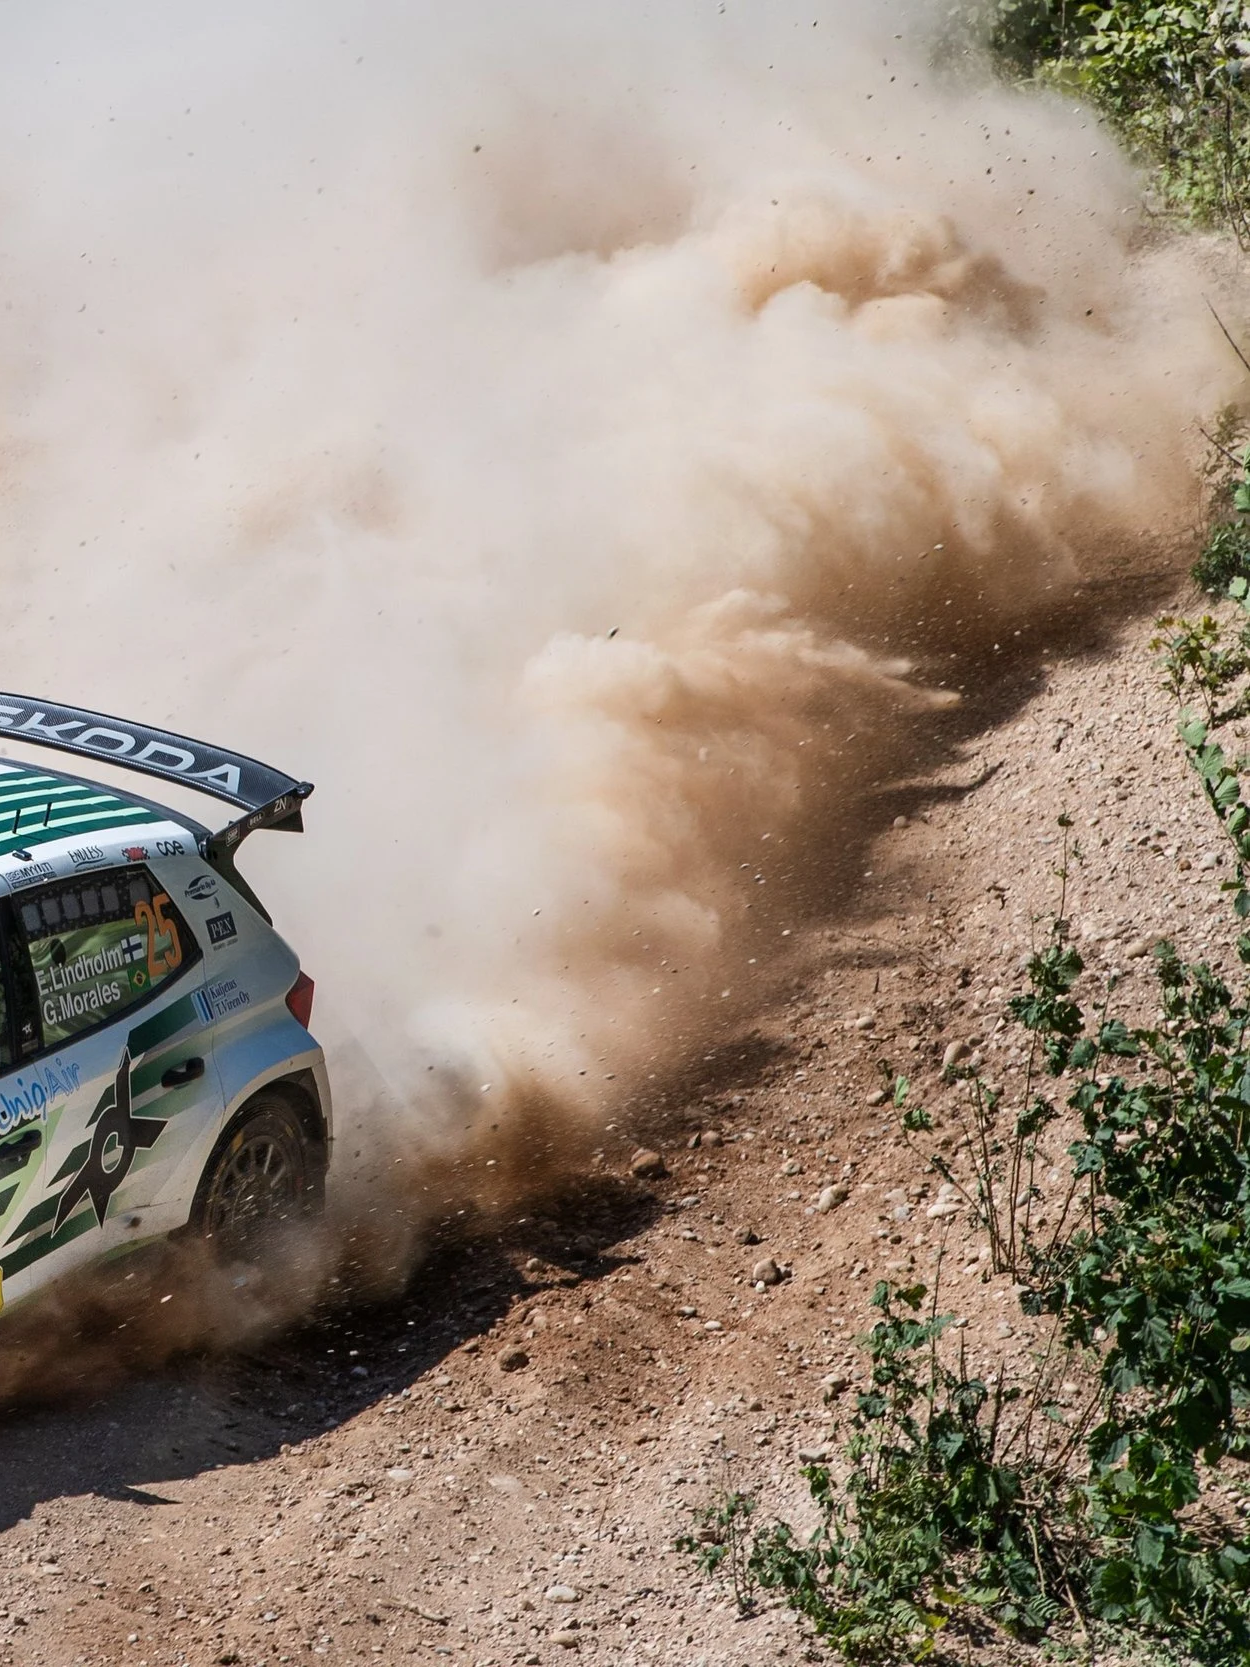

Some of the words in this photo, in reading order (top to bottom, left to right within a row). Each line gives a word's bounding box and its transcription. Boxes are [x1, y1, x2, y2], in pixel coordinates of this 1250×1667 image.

[67, 845, 104, 864] ENDLESS
[134, 893, 183, 978] 25
[35, 946, 124, 997] E.Lindholm
[208, 979, 238, 1001] Kuljetus
[42, 981, 121, 1026] G.Morales
